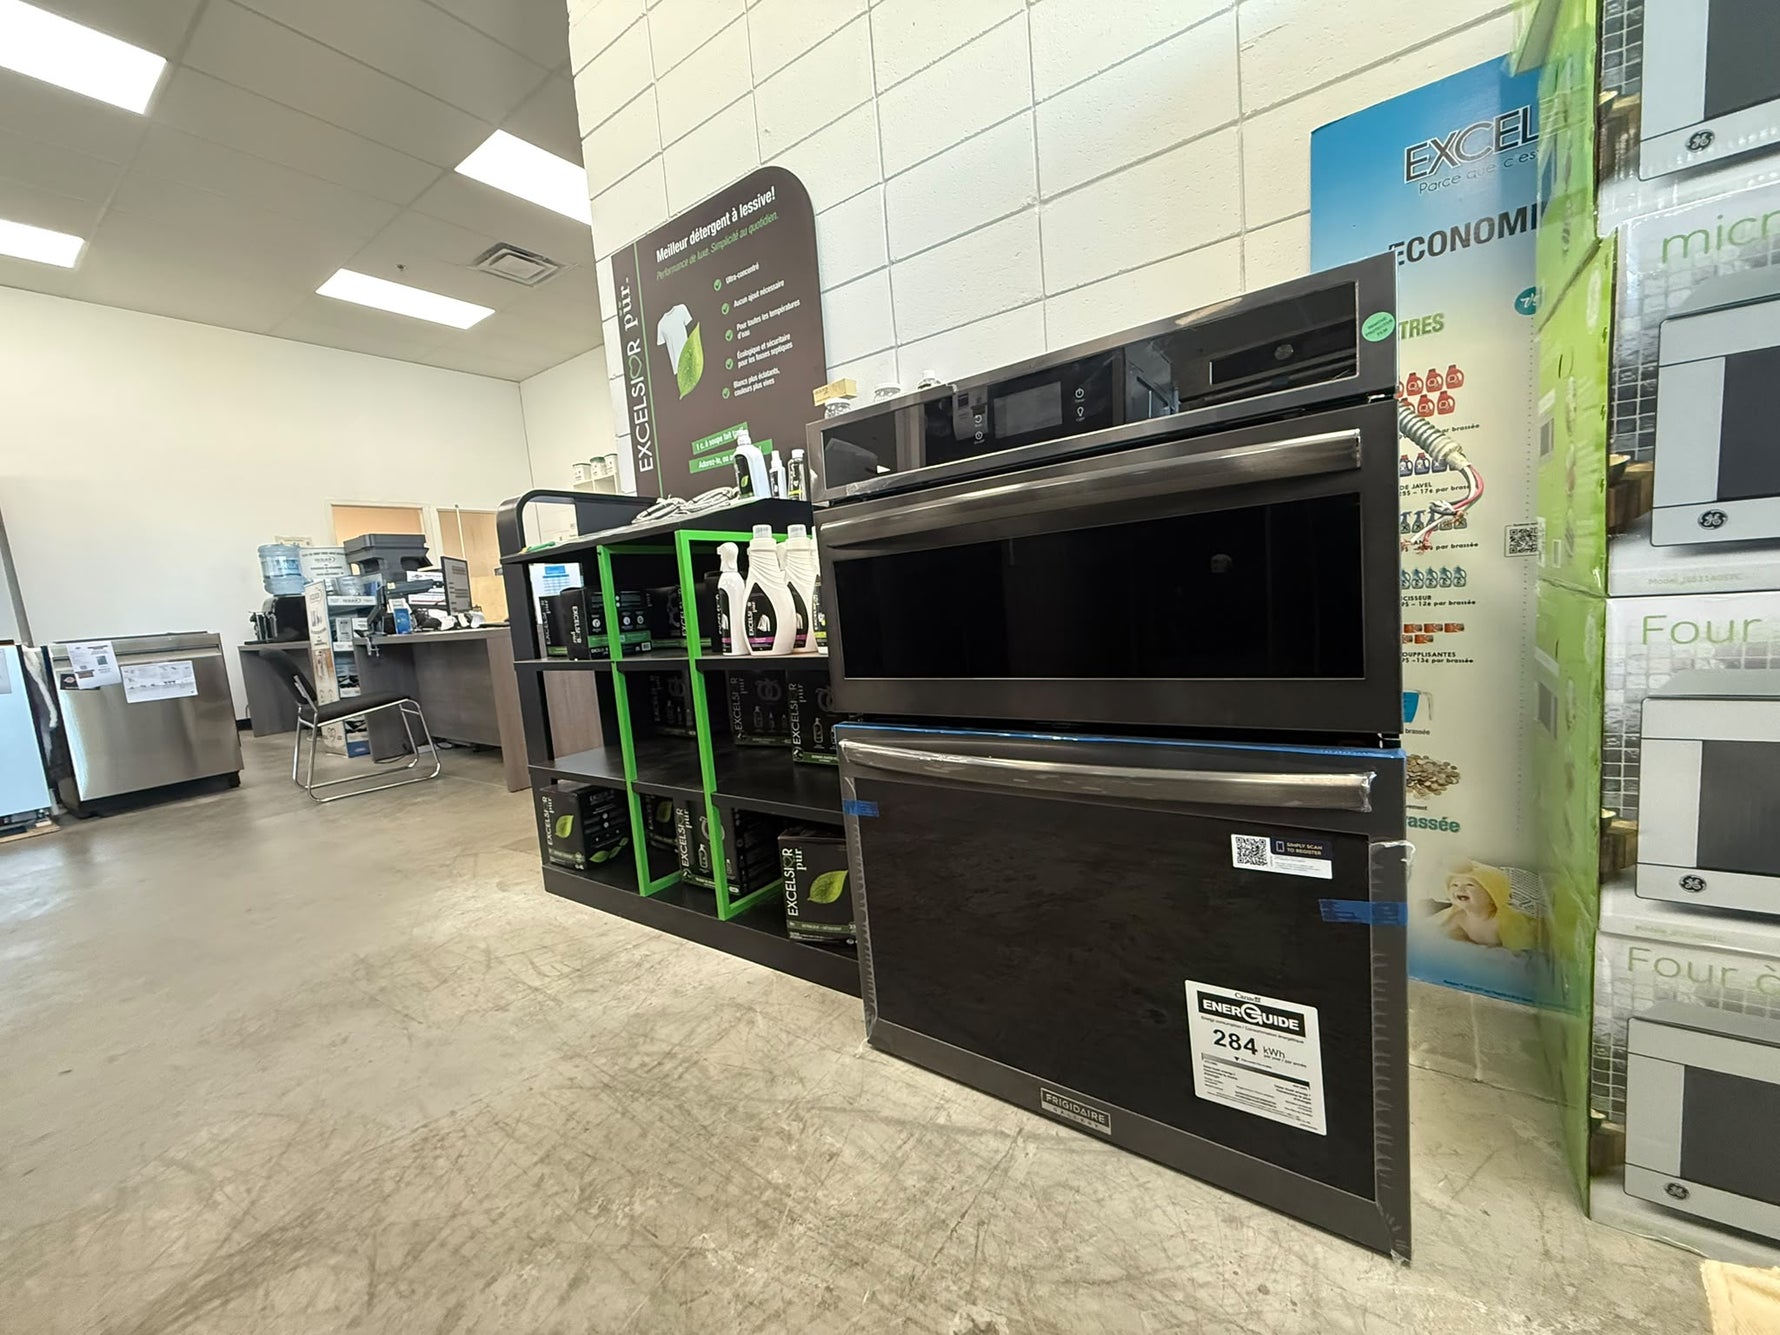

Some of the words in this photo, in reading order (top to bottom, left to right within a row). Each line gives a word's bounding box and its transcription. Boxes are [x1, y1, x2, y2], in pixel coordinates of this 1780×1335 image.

[1404, 104, 1540, 184] EXCEL
[1419, 174, 1461, 194] Parce
[1466, 164, 1498, 179] que
[656, 238, 688, 262] Meilleur
[689, 211, 731, 246] détergent
[732, 207, 738, 222] à
[739, 186, 776, 218] lessive!
[1452, 423, 1480, 432] brassée
[1412, 482, 1432, 490] JAVEL
[1436, 544, 1448, 552] par
[1450, 541, 1478, 549] brassée
[1641, 614, 1762, 646] Four
[1405, 728, 1430, 736] brassée
[1627, 946, 1738, 991] Four
[1202, 998, 1300, 1031] ENERGUIDE
[1213, 1029, 1258, 1056] 284
[1263, 1046, 1286, 1060] kWh
[1046, 1094, 1106, 1124] FRIGIDAIRE
